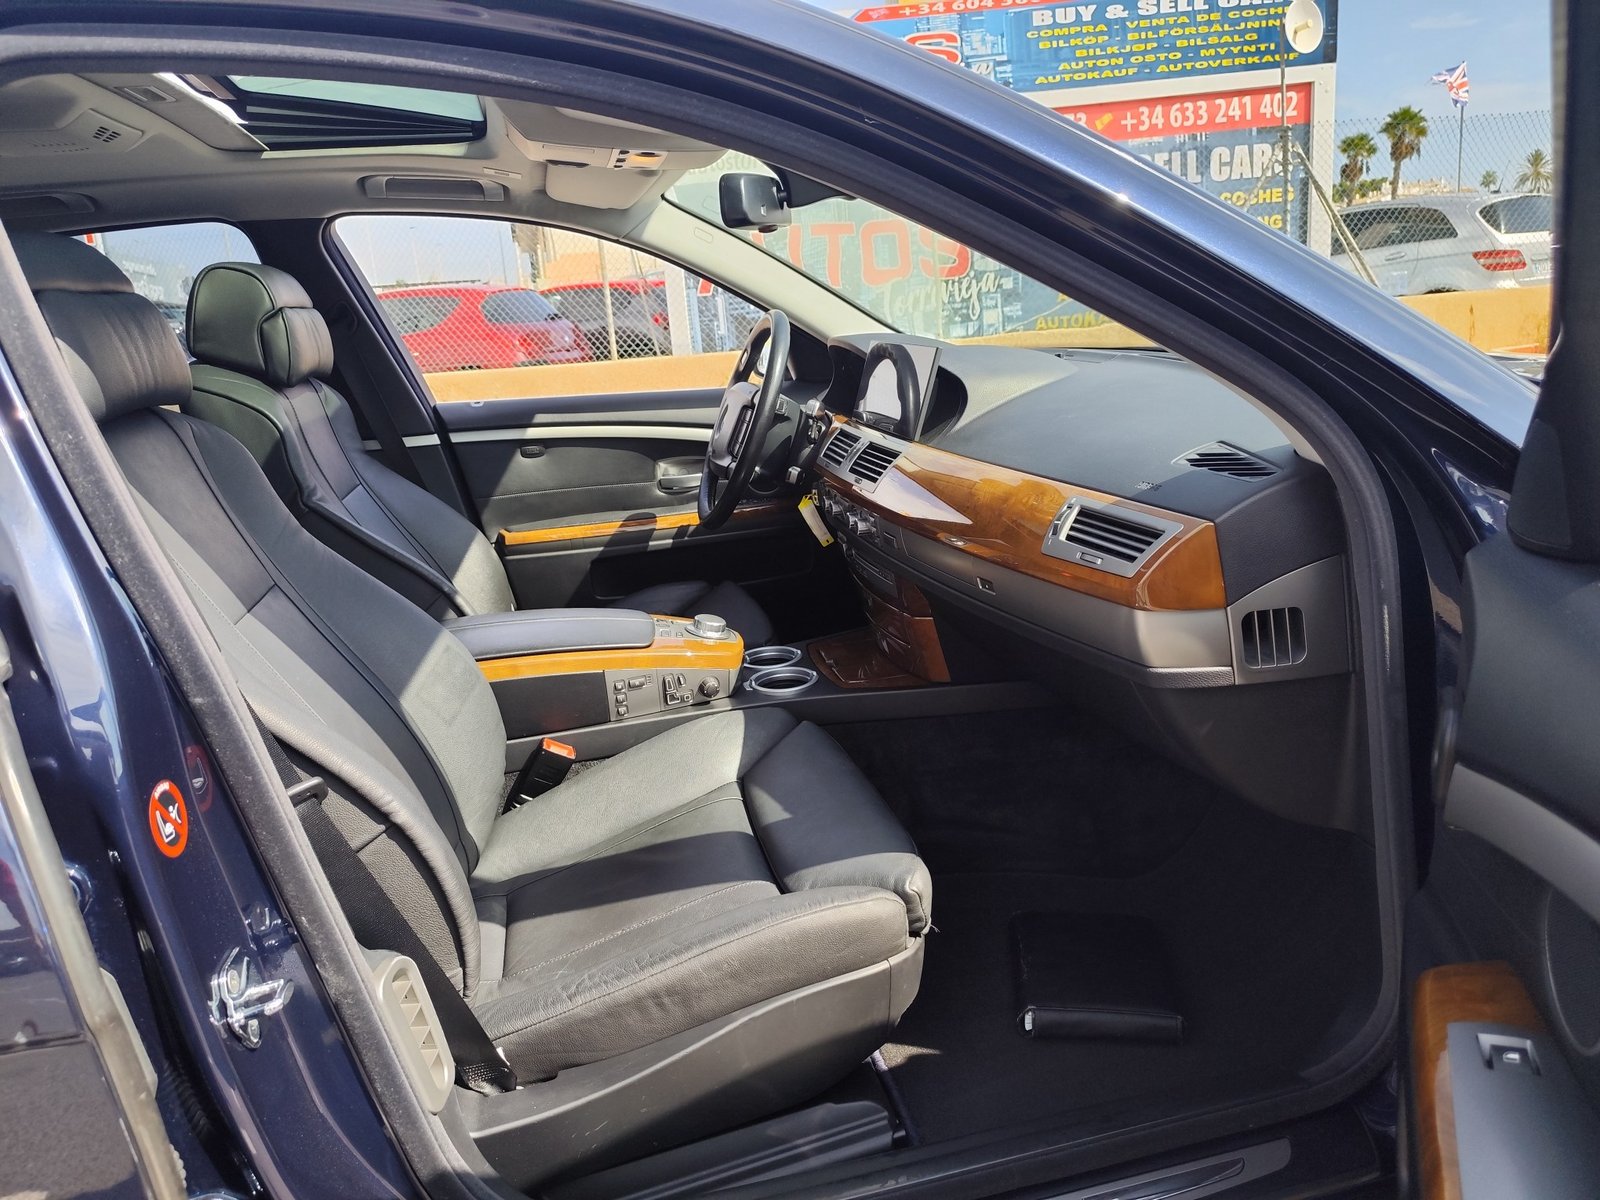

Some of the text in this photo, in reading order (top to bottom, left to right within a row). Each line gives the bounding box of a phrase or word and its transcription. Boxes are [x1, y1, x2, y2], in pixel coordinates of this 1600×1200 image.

[898, 3, 946, 16] +34
[1032, 5, 1097, 27] BUY
[1105, 4, 1129, 20] &
[1137, 0, 1210, 16] SELL
[1026, 23, 1108, 39] COMPRA
[1126, 16, 1190, 29] VENTA
[1196, 12, 1222, 22] DE
[1038, 35, 1109, 49] BILKÖP
[1127, 18, 1282, 41] BILFÖRSÄLJNIN
[1035, 67, 1138, 85] AUTOKAUF
[1156, 52, 1300, 74] AUTOVERKAUF
[1057, 57, 1124, 71] AUTON
[1130, 52, 1183, 64] OSTO
[1200, 43, 1276, 58] MYYNTI
[1120, 104, 1164, 133] +34
[1169, 100, 1209, 128] 633
[1215, 95, 1252, 125] 241
[1260, 91, 1298, 119] 402
